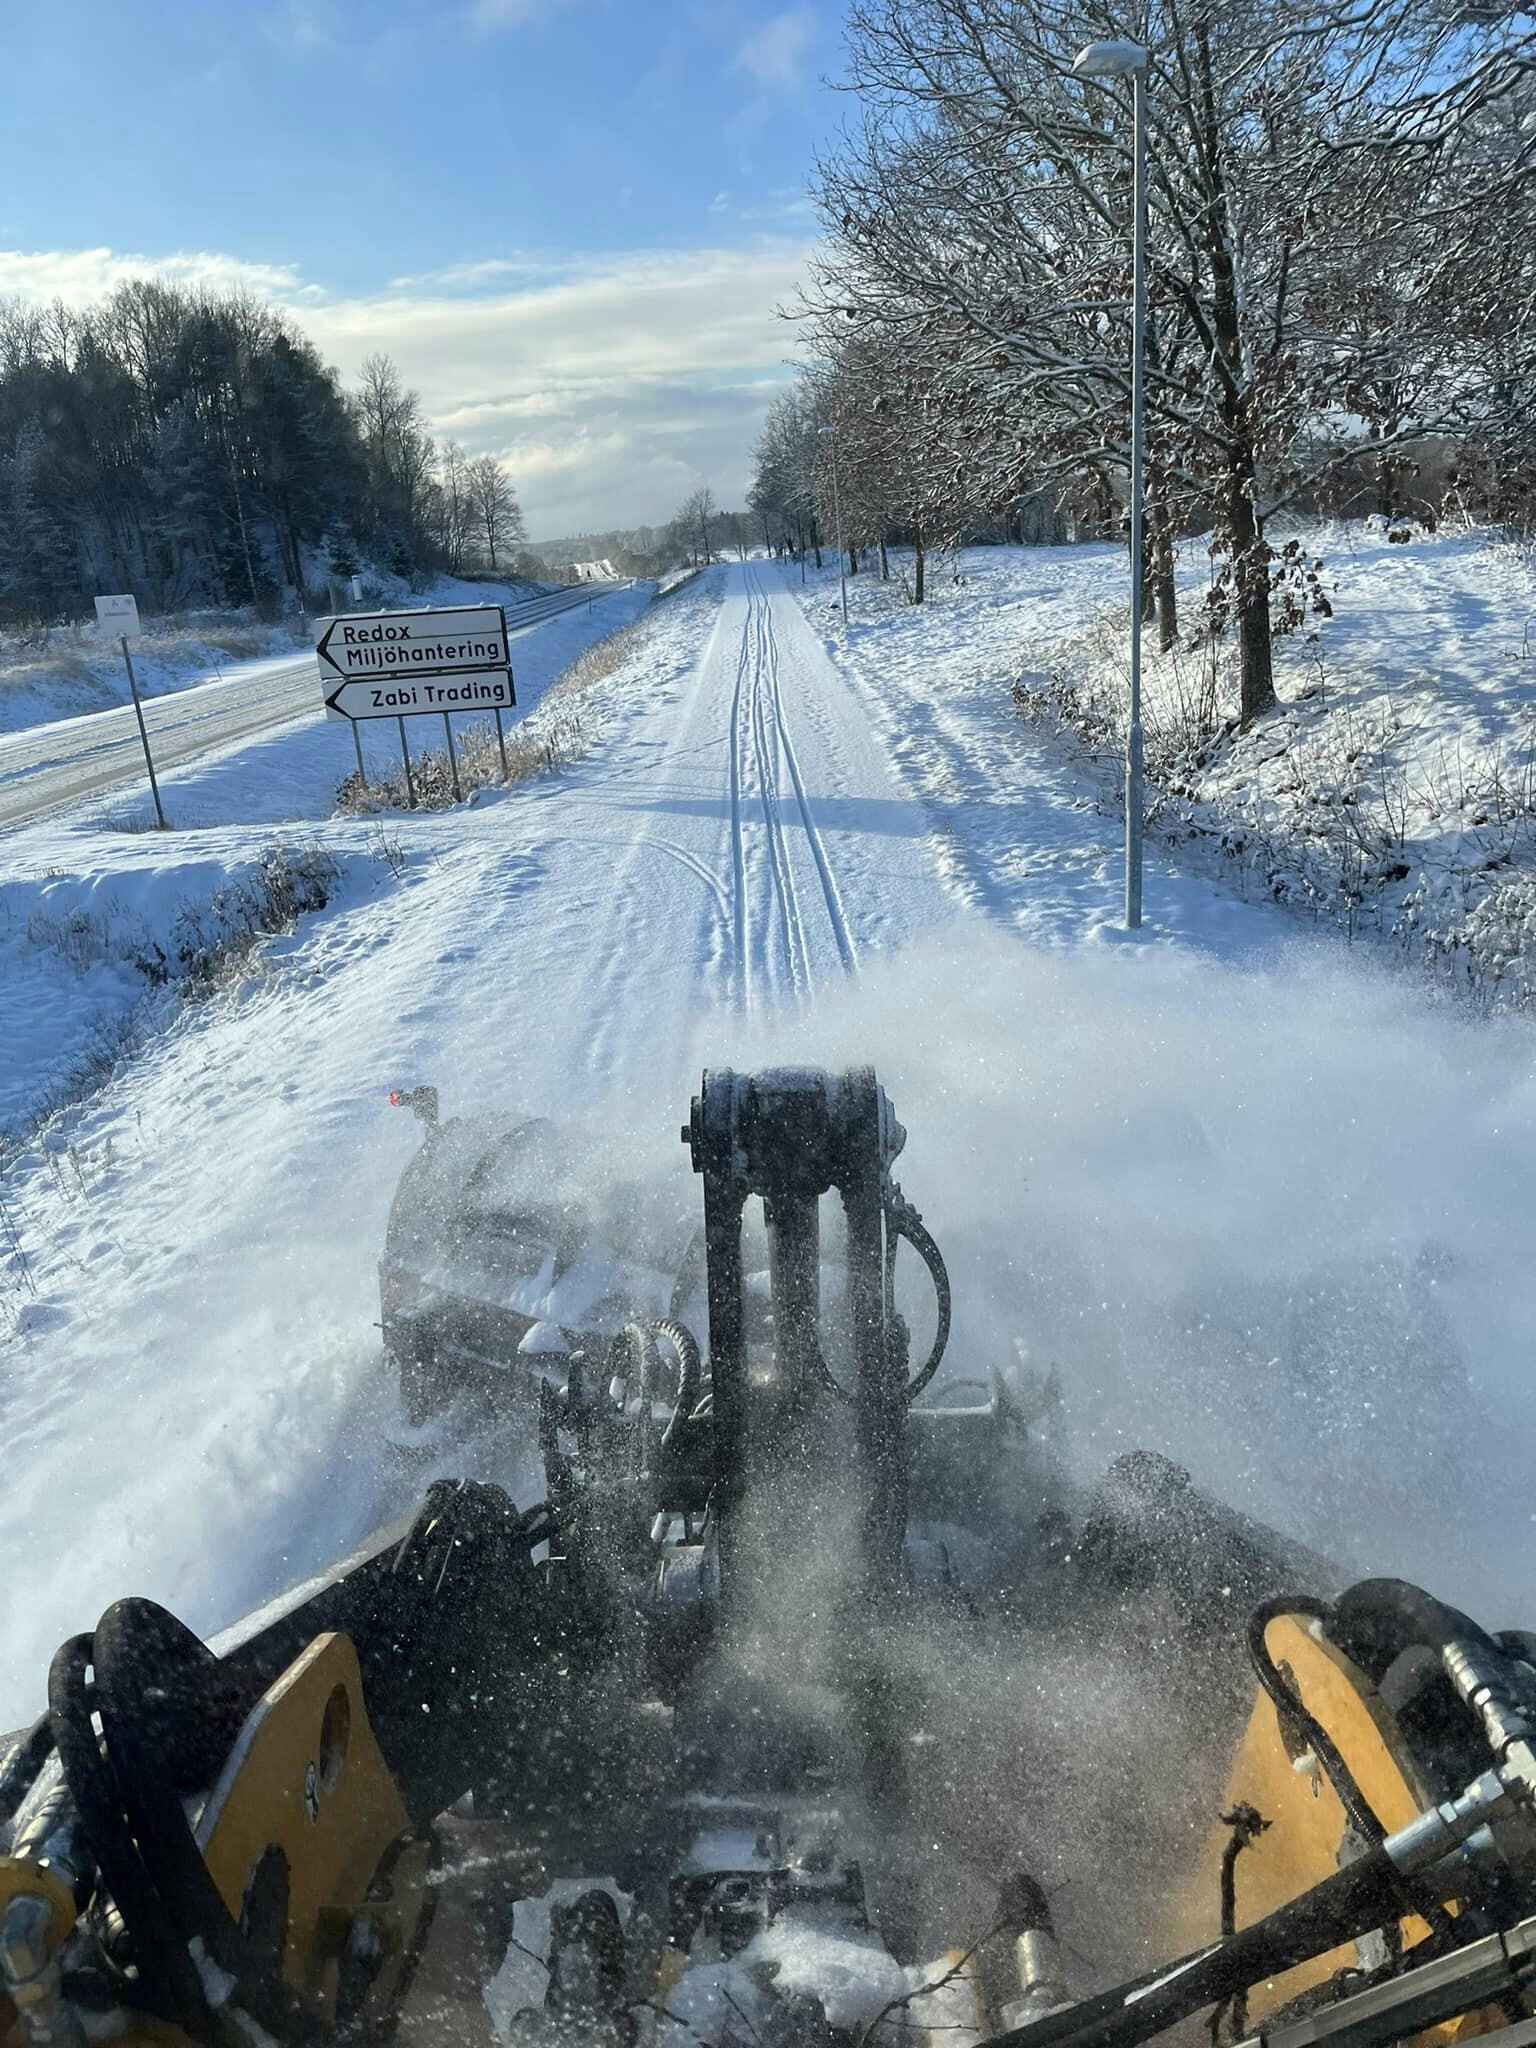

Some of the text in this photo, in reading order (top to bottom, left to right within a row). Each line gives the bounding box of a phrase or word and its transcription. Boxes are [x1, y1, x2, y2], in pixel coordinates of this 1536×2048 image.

[343, 623, 411, 644] Redox
[346, 640, 499, 668] Miljöhantering
[370, 681, 505, 708] Zabi Trading
